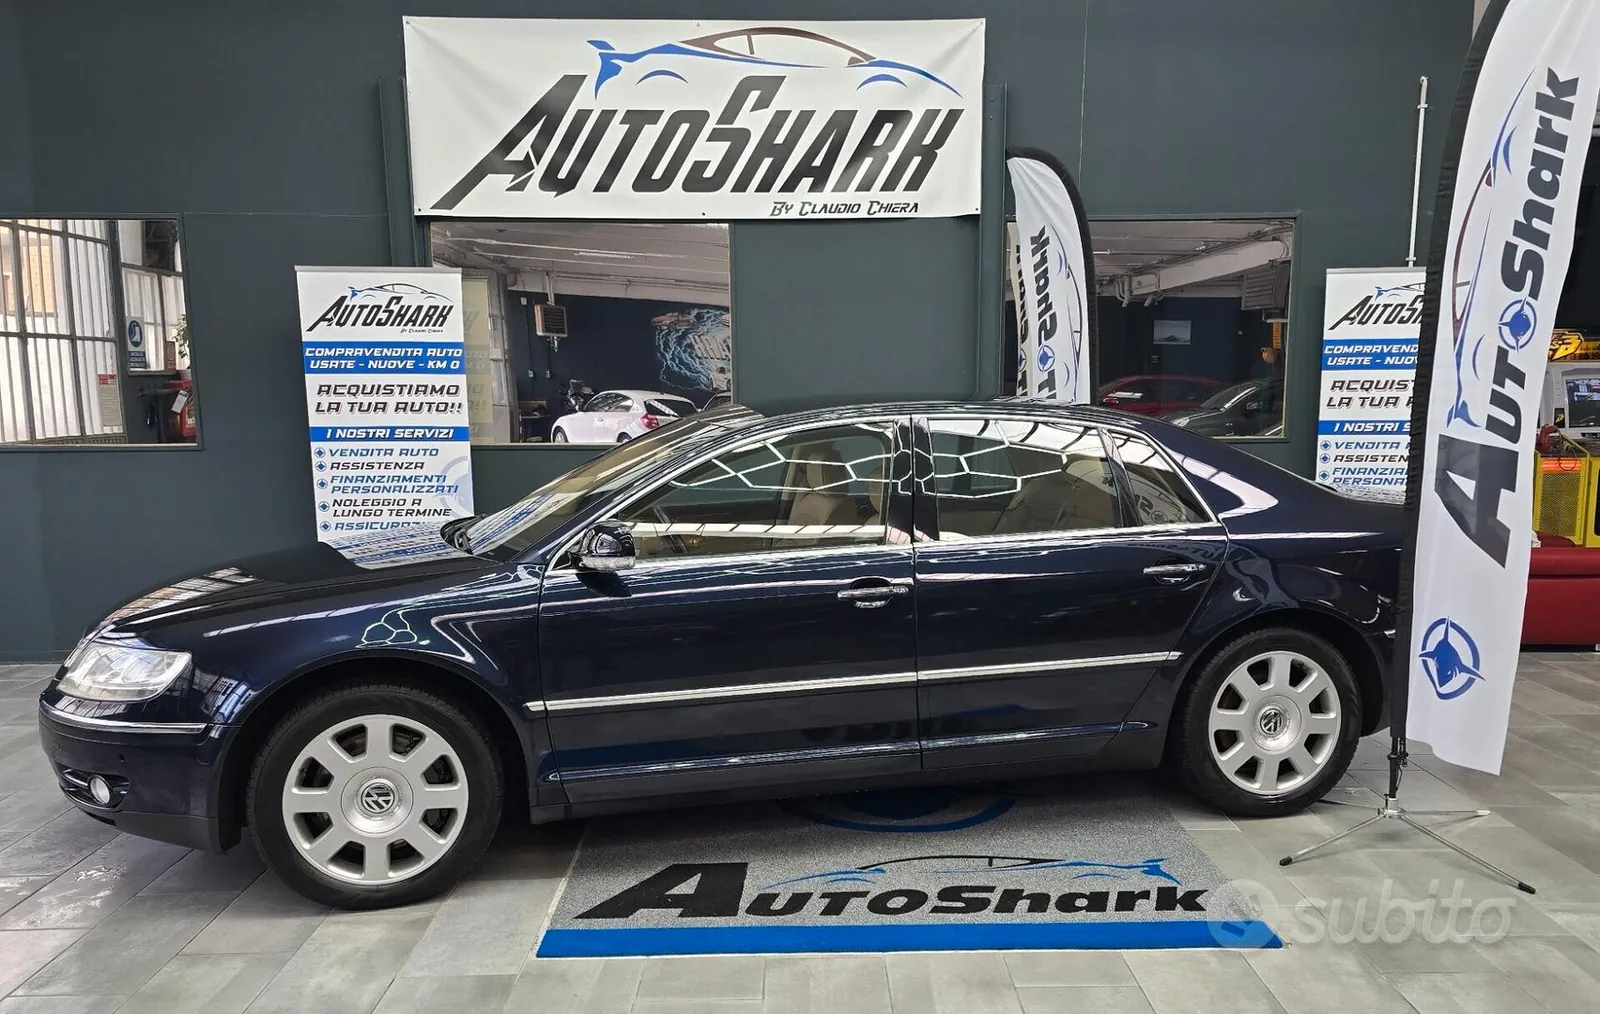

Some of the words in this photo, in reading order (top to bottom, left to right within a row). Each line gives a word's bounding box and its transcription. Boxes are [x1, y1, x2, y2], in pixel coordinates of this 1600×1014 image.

[1328, 294, 1425, 331] AUTOS
[305, 348, 423, 357] COMPRAVENDITA
[426, 348, 463, 357] AUTO
[310, 360, 355, 369] USATE
[367, 360, 415, 369] NUOVE
[427, 360, 446, 369] KM
[1327, 356, 1372, 366] USATE
[317, 384, 460, 397] ACQUISTIAMO
[1330, 380, 1416, 392] ACQUIS
[1326, 396, 1352, 408] LA
[1359, 396, 1400, 408] TUA
[315, 402, 342, 413] LA
[347, 402, 388, 413] TUA
[394, 402, 463, 413] AUTO!!
[1334, 422, 1340, 432] I
[1343, 422, 1399, 432] NOSTRI
[326, 428, 332, 438] I
[335, 428, 390, 438] NOSTRI
[394, 428, 454, 438] SERVIZI
[1335, 441, 1401, 450] VENDITA
[329, 448, 394, 457] VENDITA
[398, 448, 439, 457] AUTO
[330, 461, 425, 470] ASSISTENZA
[330, 474, 447, 484] FINANZIAMENTI
[331, 485, 459, 494] PERSONALIZZATI
[332, 498, 406, 507] NOLEGGIO
[411, 498, 422, 507] A
[332, 509, 383, 518] LUNGO
[387, 508, 452, 517] TERMINE
